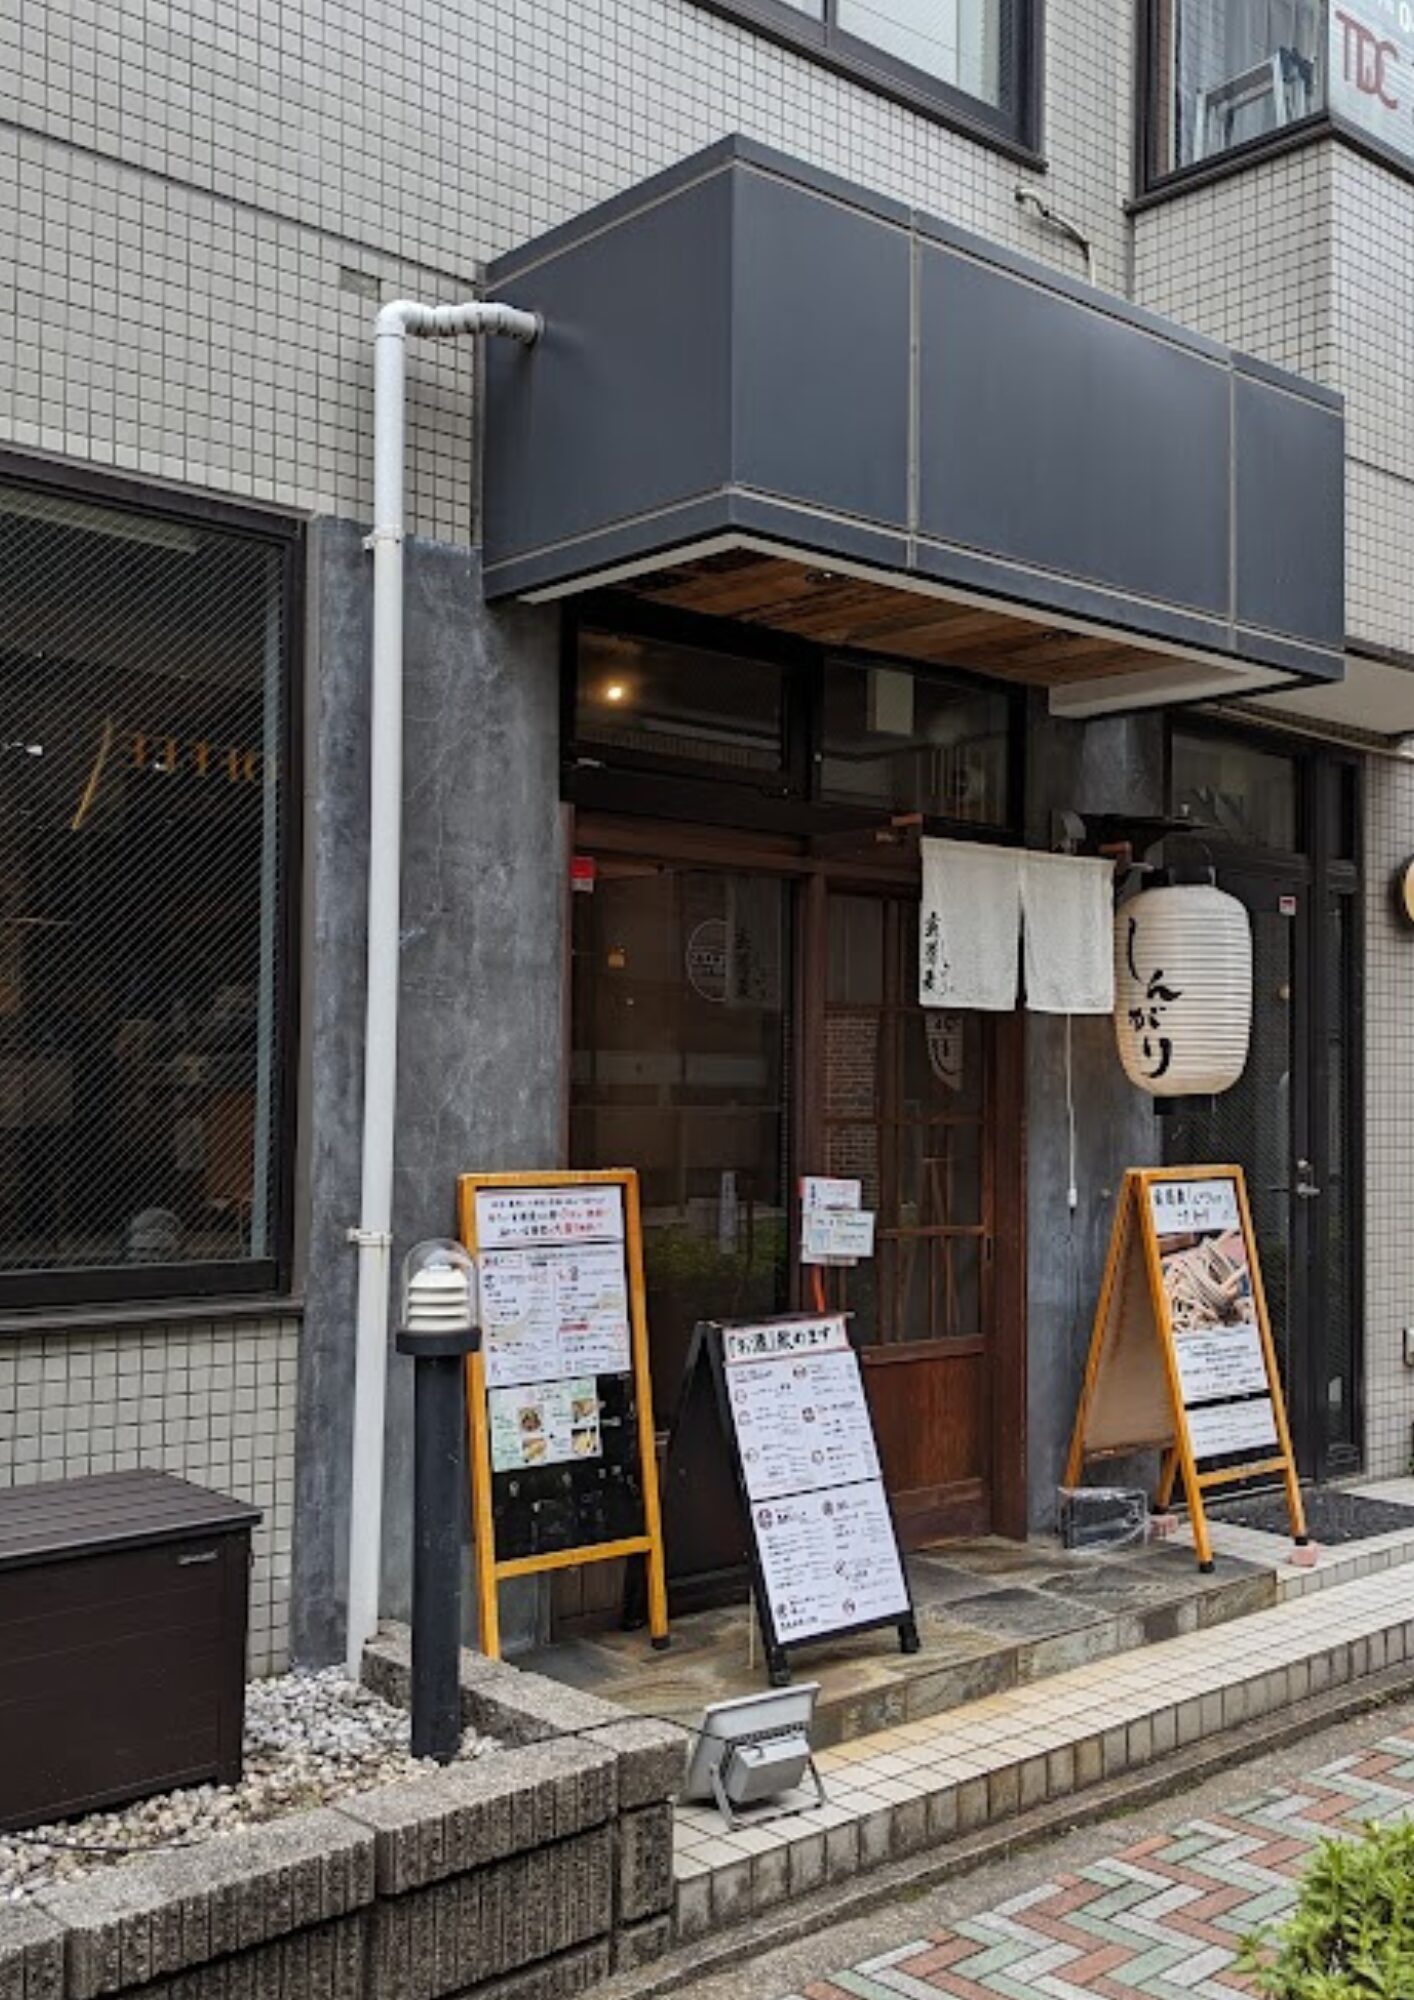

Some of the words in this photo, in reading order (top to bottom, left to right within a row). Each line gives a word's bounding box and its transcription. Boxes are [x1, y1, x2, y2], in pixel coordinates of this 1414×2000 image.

[1335, 10, 1399, 110] TDC
[1127, 916, 1183, 1079] しんがり
